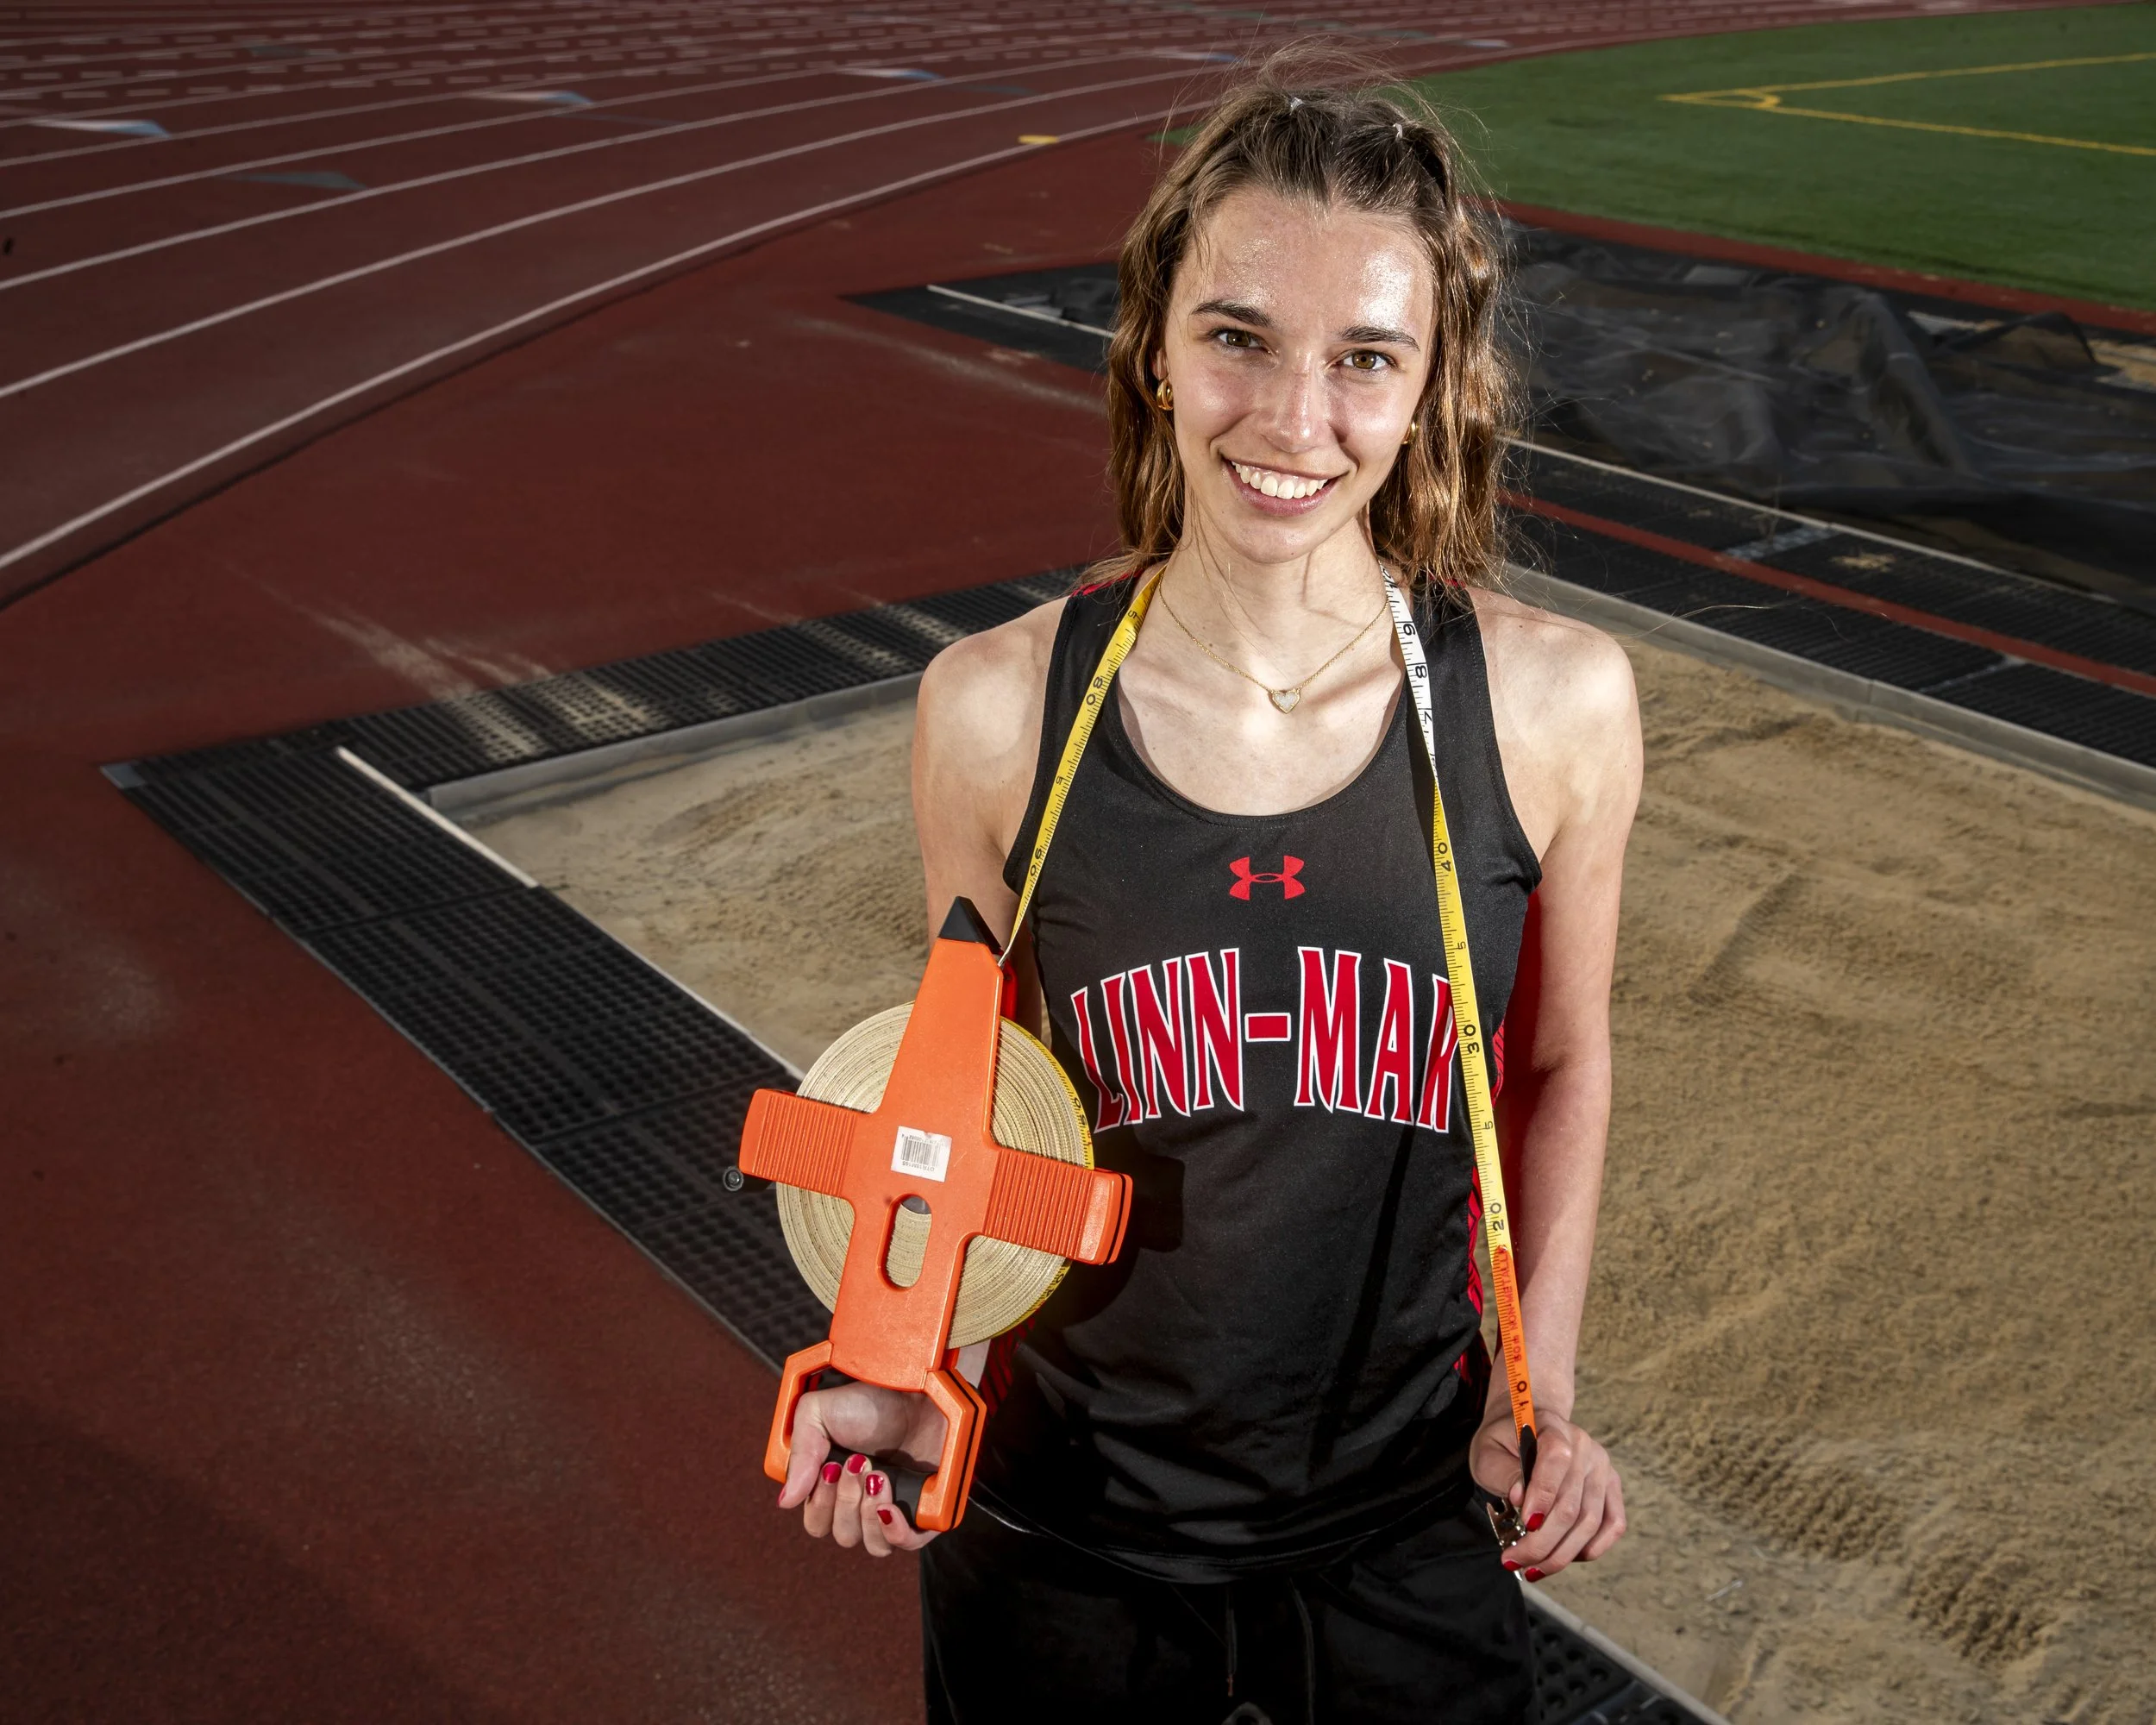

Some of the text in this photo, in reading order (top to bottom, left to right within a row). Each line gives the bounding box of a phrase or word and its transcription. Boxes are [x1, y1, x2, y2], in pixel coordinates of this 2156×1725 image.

[1127, 610, 1138, 618] 5
[1415, 665, 1427, 679] 8
[1086, 676, 1104, 706] 80
[1056, 775, 1065, 785] 5
[1438, 842, 1451, 872] 40
[1457, 941, 1466, 950] 5
[1070, 945, 1457, 1134] LINN-MAR
[1463, 1024, 1480, 1054] 30
[1484, 1120, 1493, 1130] 5
[1489, 1202, 1505, 1232] 20
[1516, 1380, 1529, 1407] 10
